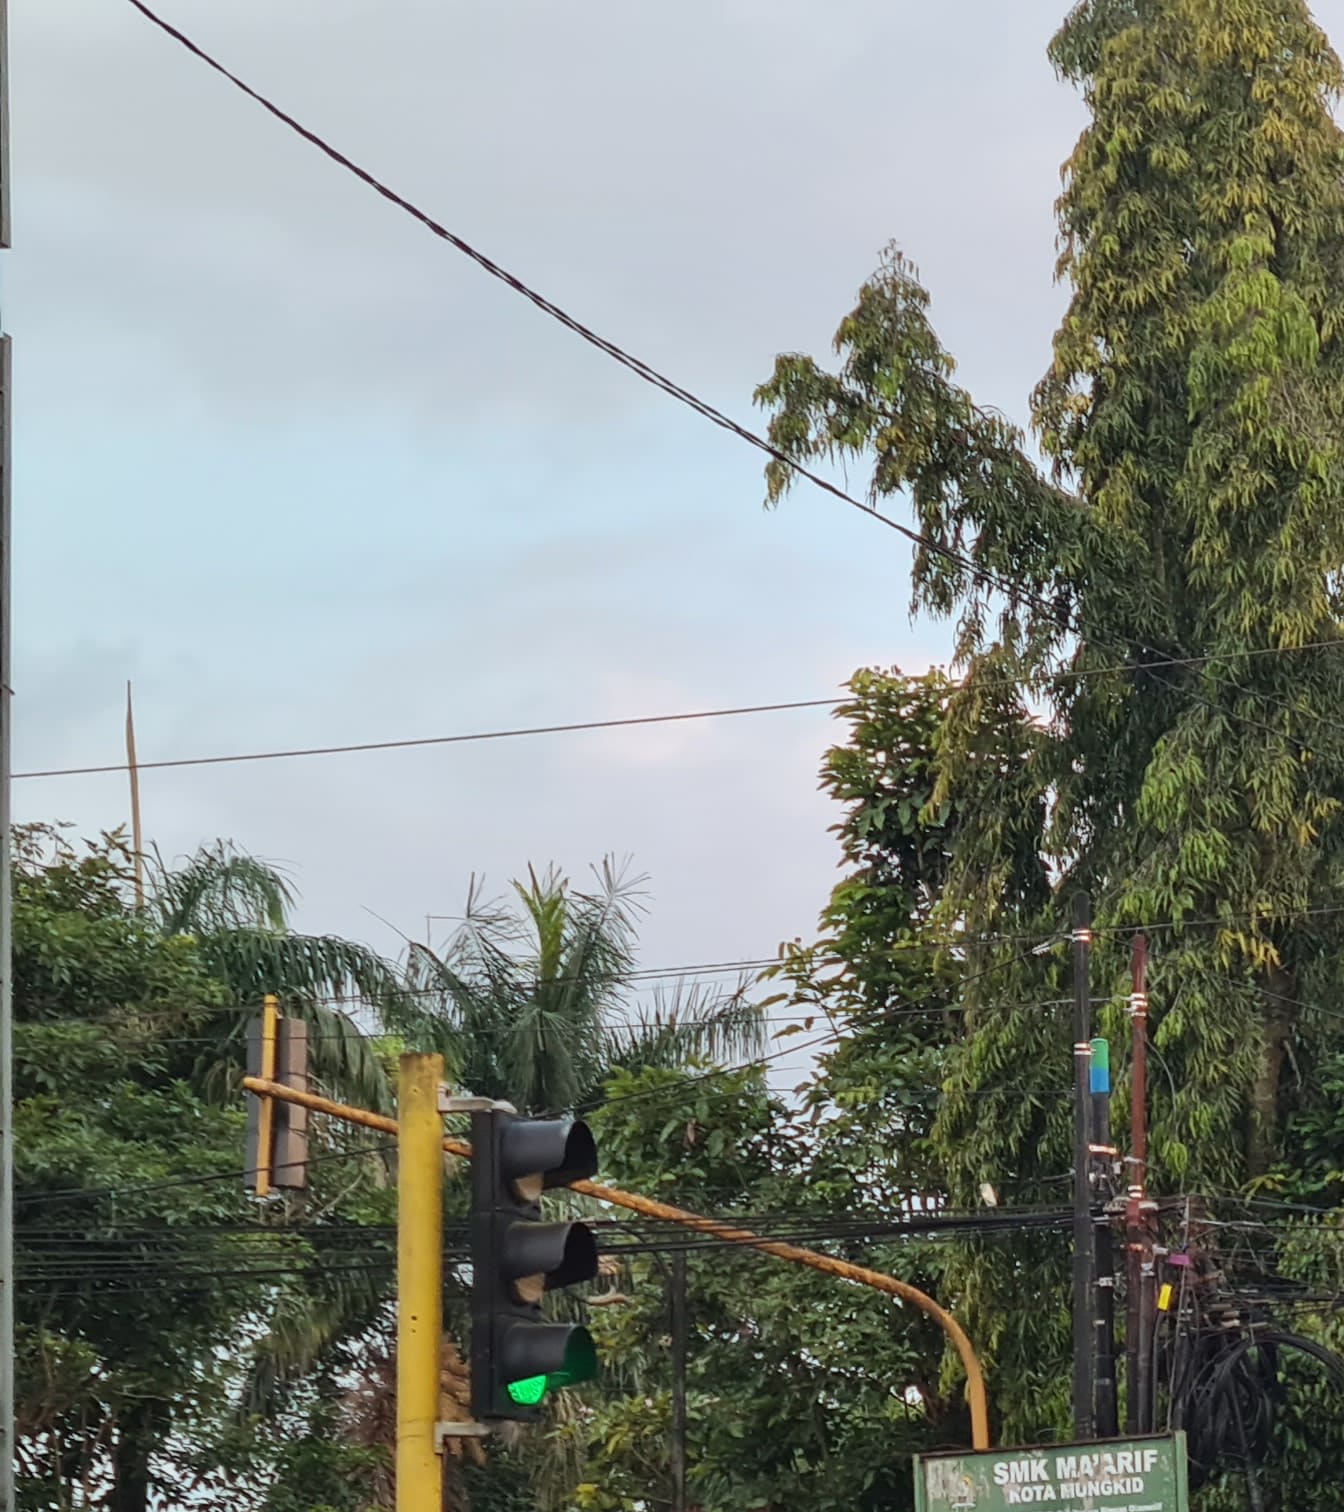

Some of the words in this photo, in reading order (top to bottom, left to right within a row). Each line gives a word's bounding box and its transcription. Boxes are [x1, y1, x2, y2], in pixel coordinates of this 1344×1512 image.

[994, 1458, 1050, 1485] SMK
[1056, 1449, 1158, 1480] MA'ARIF
[1009, 1484, 1056, 1504] KOTA
[1060, 1477, 1144, 1499] MUNGKID
